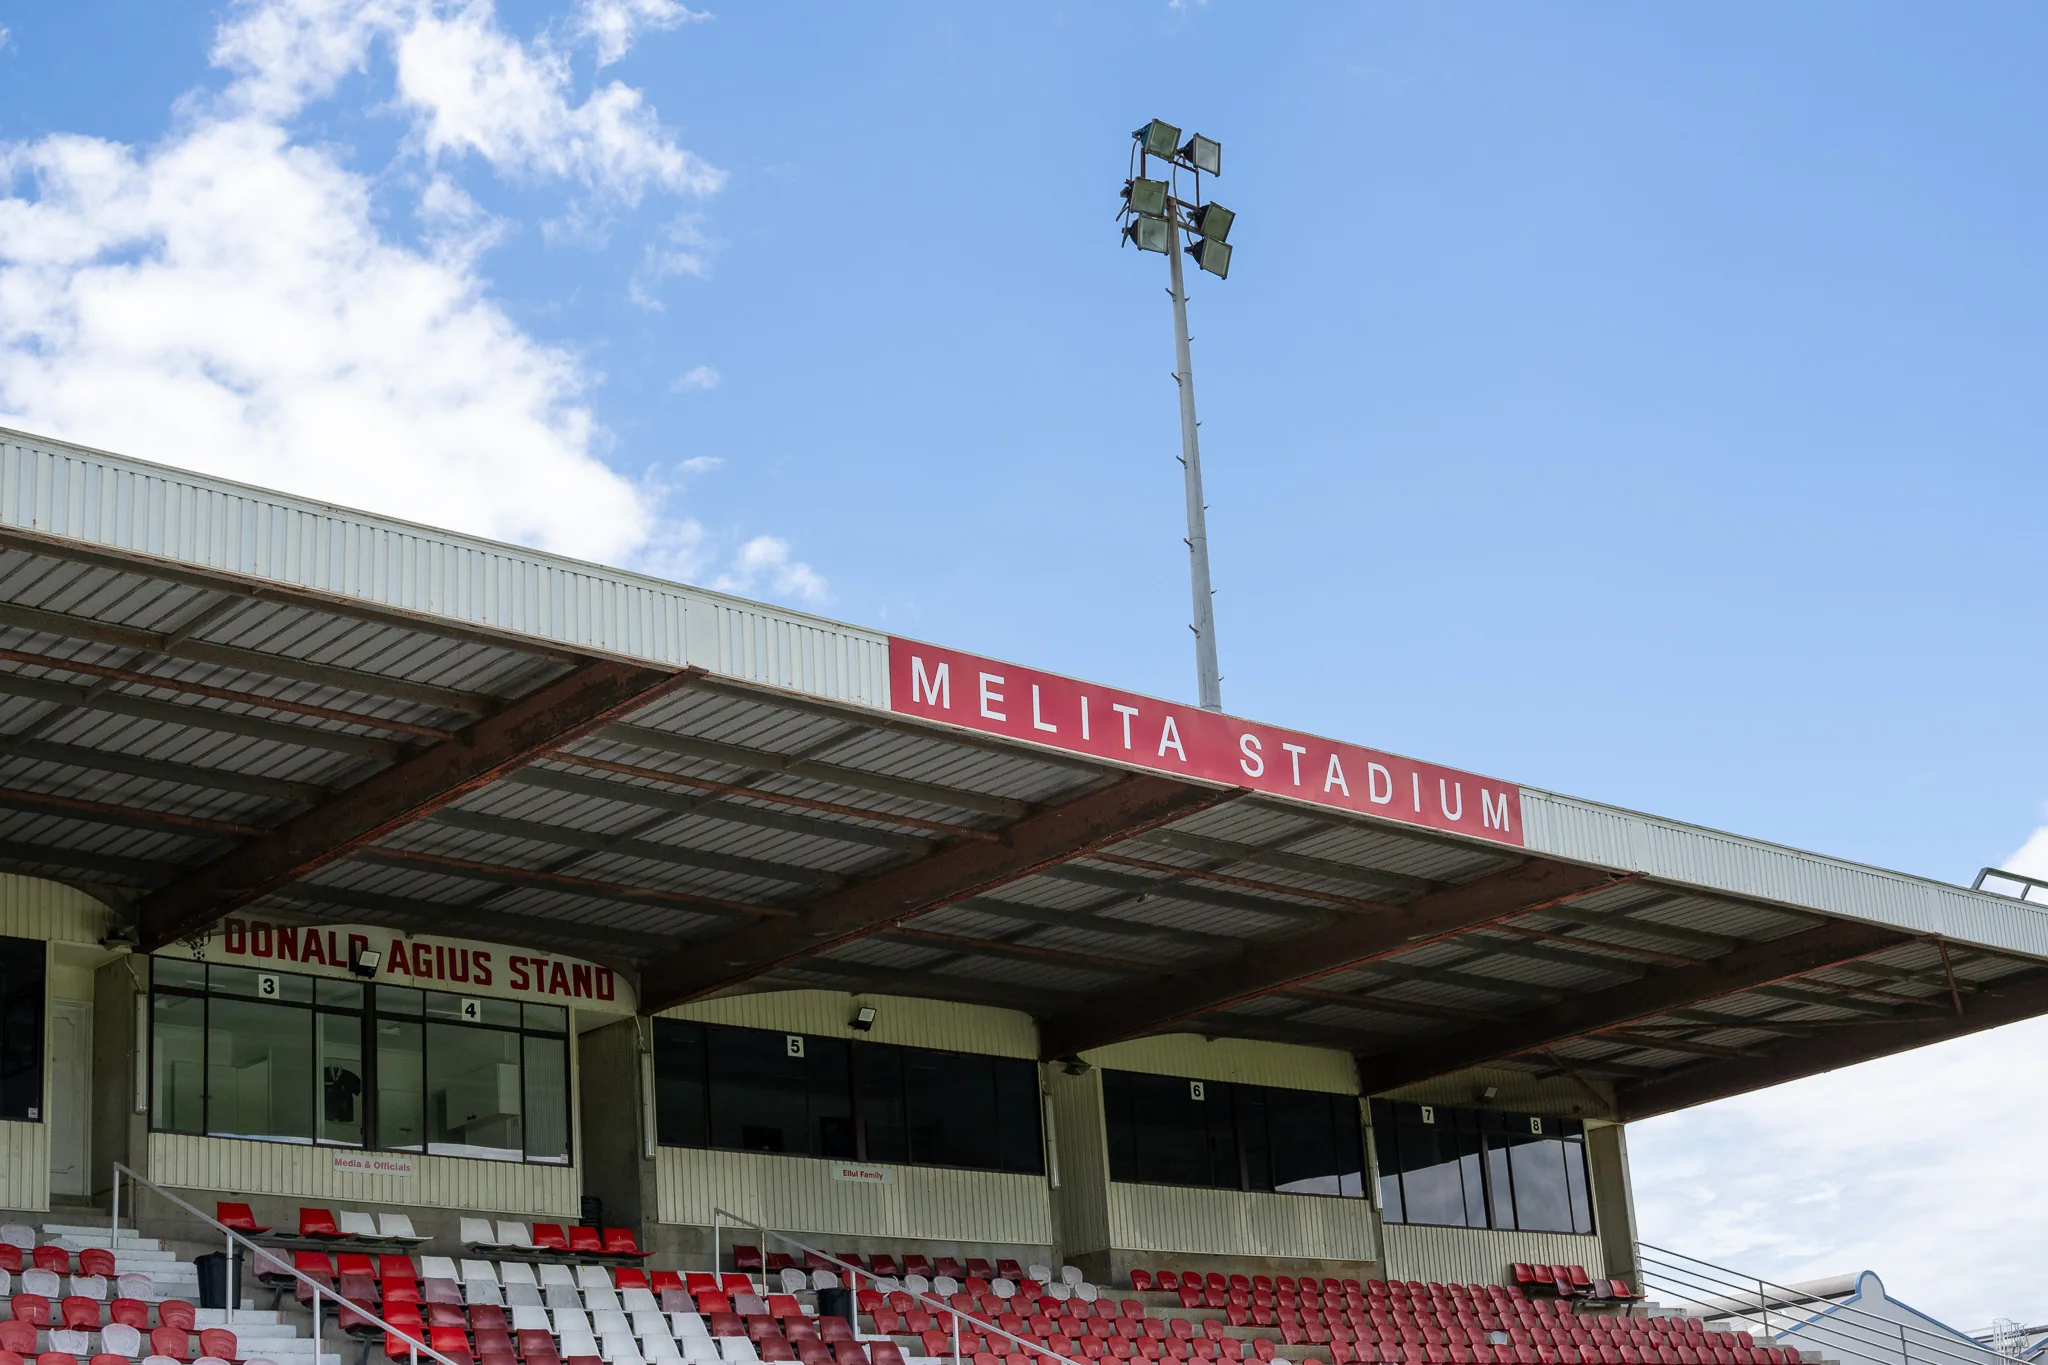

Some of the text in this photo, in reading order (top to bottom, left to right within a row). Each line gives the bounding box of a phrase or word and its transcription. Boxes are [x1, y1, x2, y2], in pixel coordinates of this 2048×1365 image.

[911, 655, 1510, 832] MELITA STADIUM
[224, 917, 614, 1001] DONALD AGIUS STAND
[263, 978, 275, 995] 3
[464, 1002, 477, 1018] 4
[790, 1038, 801, 1054] 5
[1193, 1084, 1202, 1098] 6
[1424, 1108, 1432, 1121] 7
[1532, 1119, 1540, 1132] 8
[334, 1158, 411, 1172] Media & Officials
[859, 1170, 884, 1181] Family
